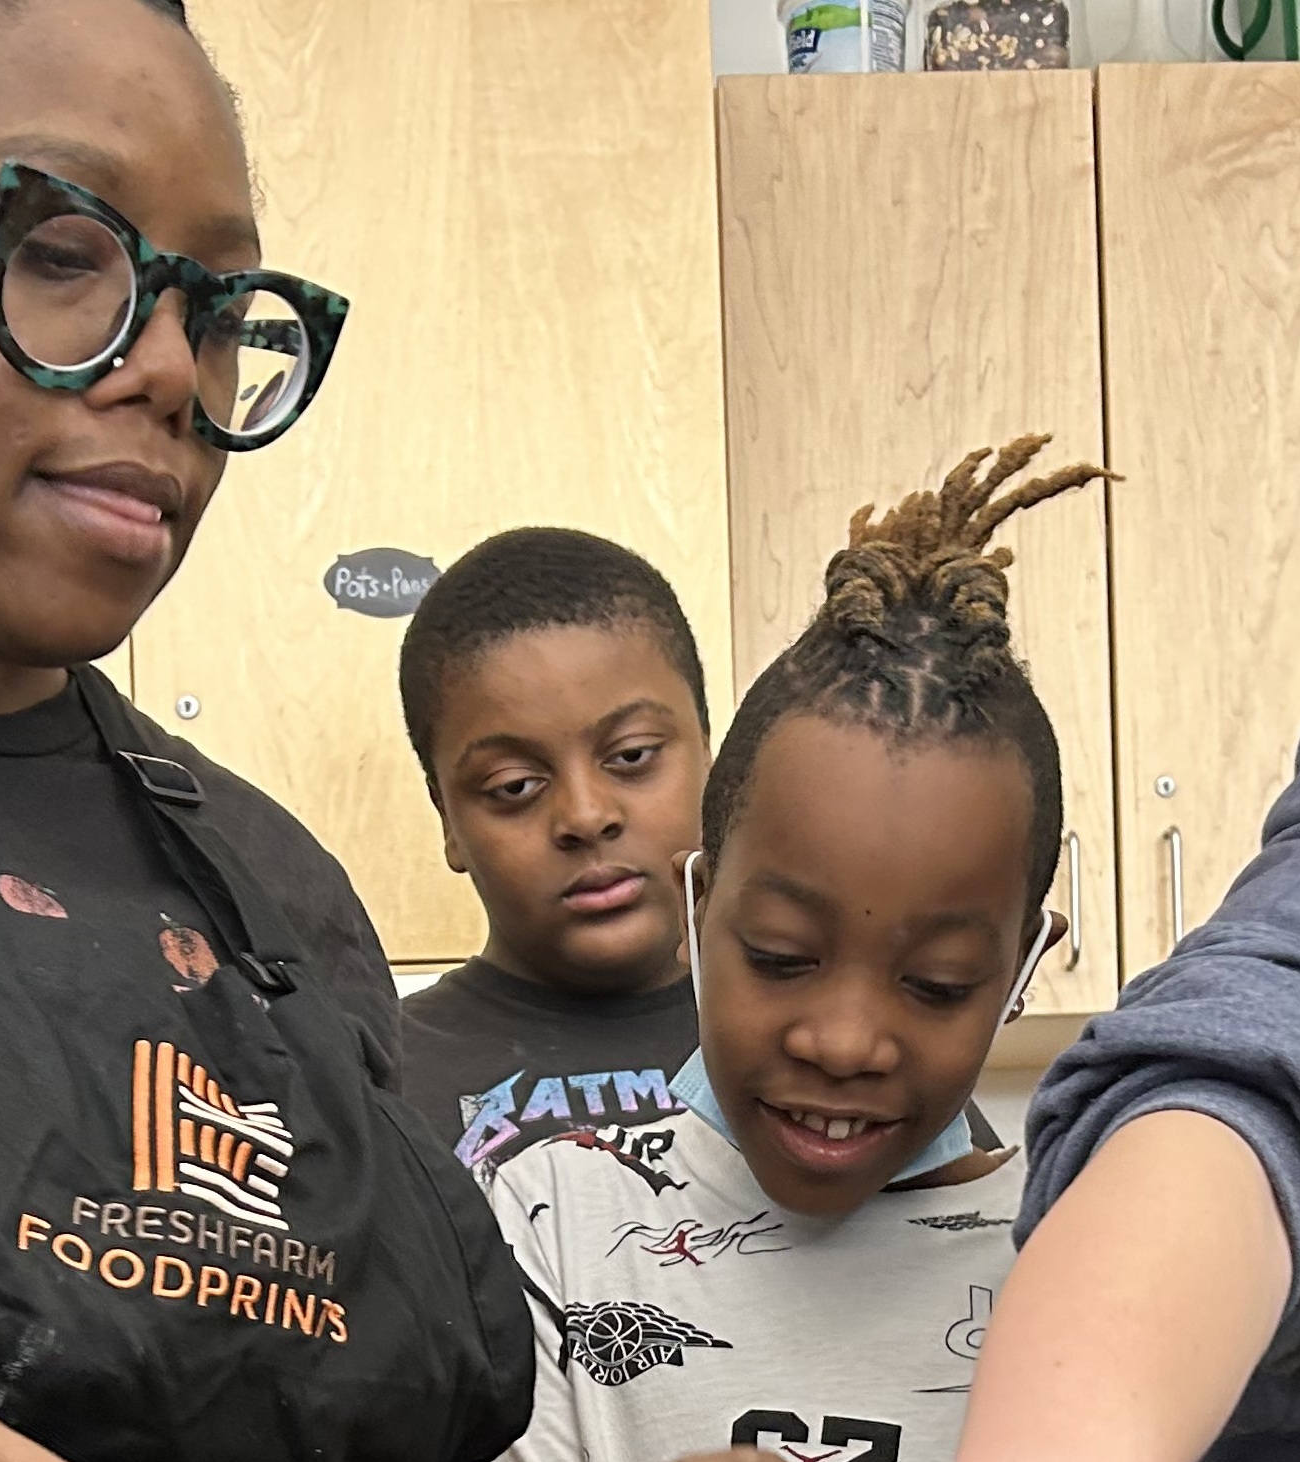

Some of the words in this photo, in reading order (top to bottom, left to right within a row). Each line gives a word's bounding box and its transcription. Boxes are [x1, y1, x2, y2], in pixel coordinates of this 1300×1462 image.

[72, 1196, 337, 1286] FRESHFARM
[572, 1341, 631, 1385] JORDA
[631, 1346, 677, 1371] AIR
